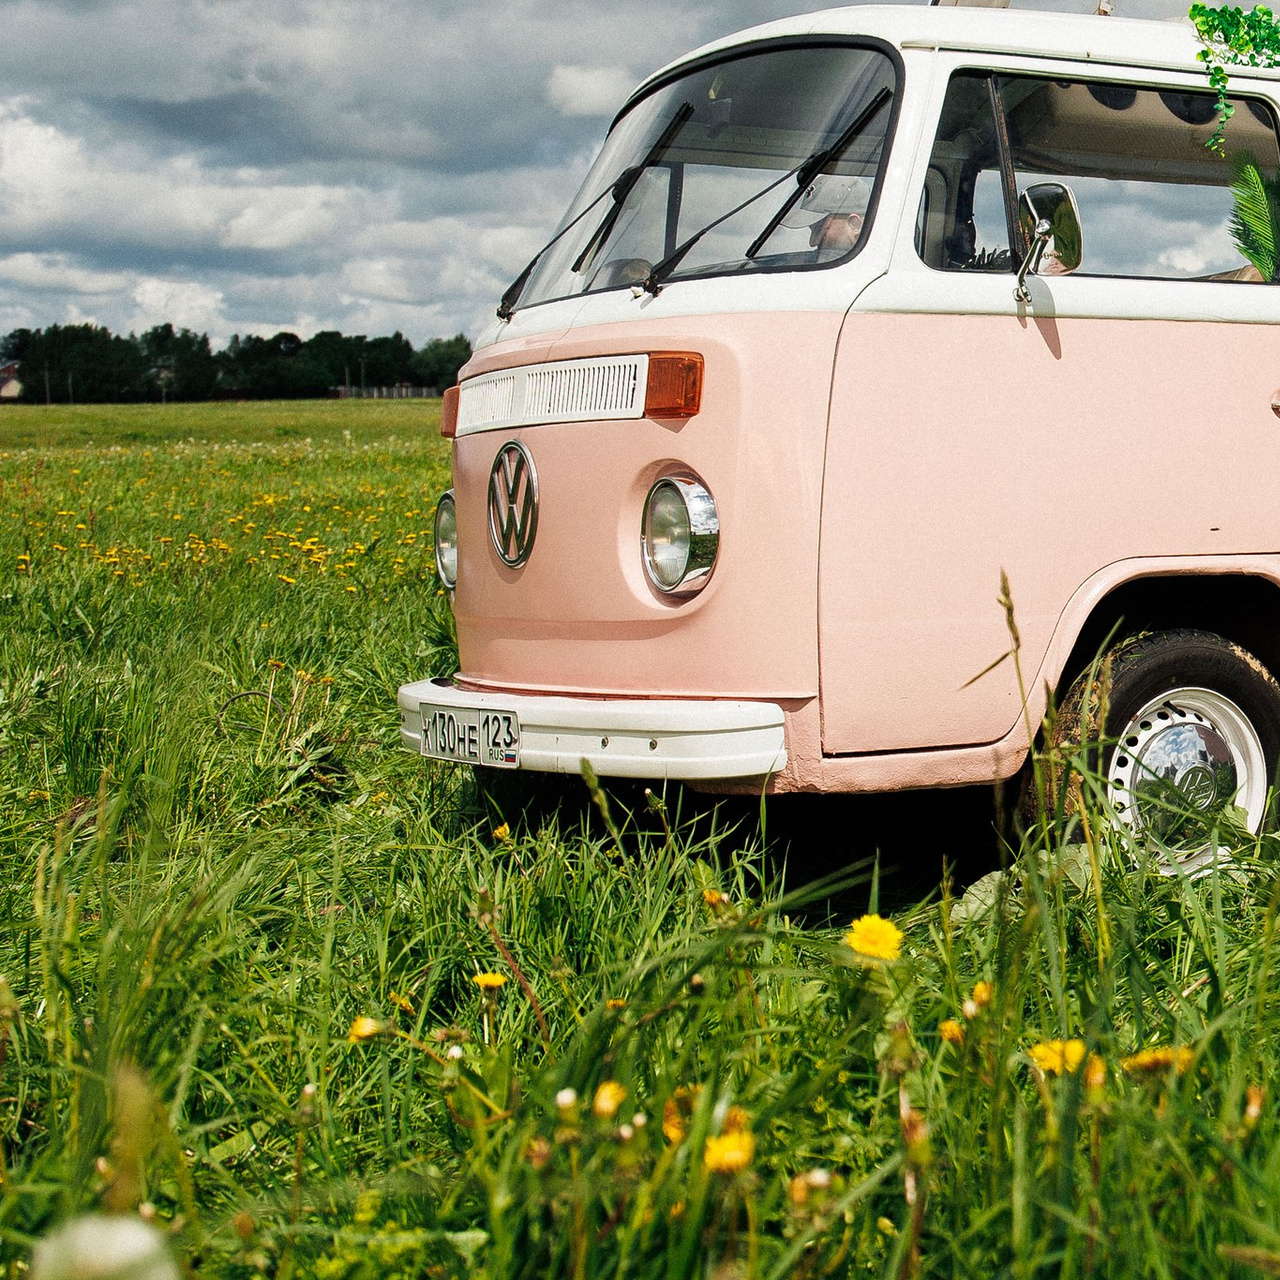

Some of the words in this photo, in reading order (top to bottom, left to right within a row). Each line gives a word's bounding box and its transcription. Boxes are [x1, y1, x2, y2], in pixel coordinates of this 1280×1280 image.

[489, 441, 538, 568] VW
[483, 713, 513, 748] 123
[489, 748, 504, 761] RUS
